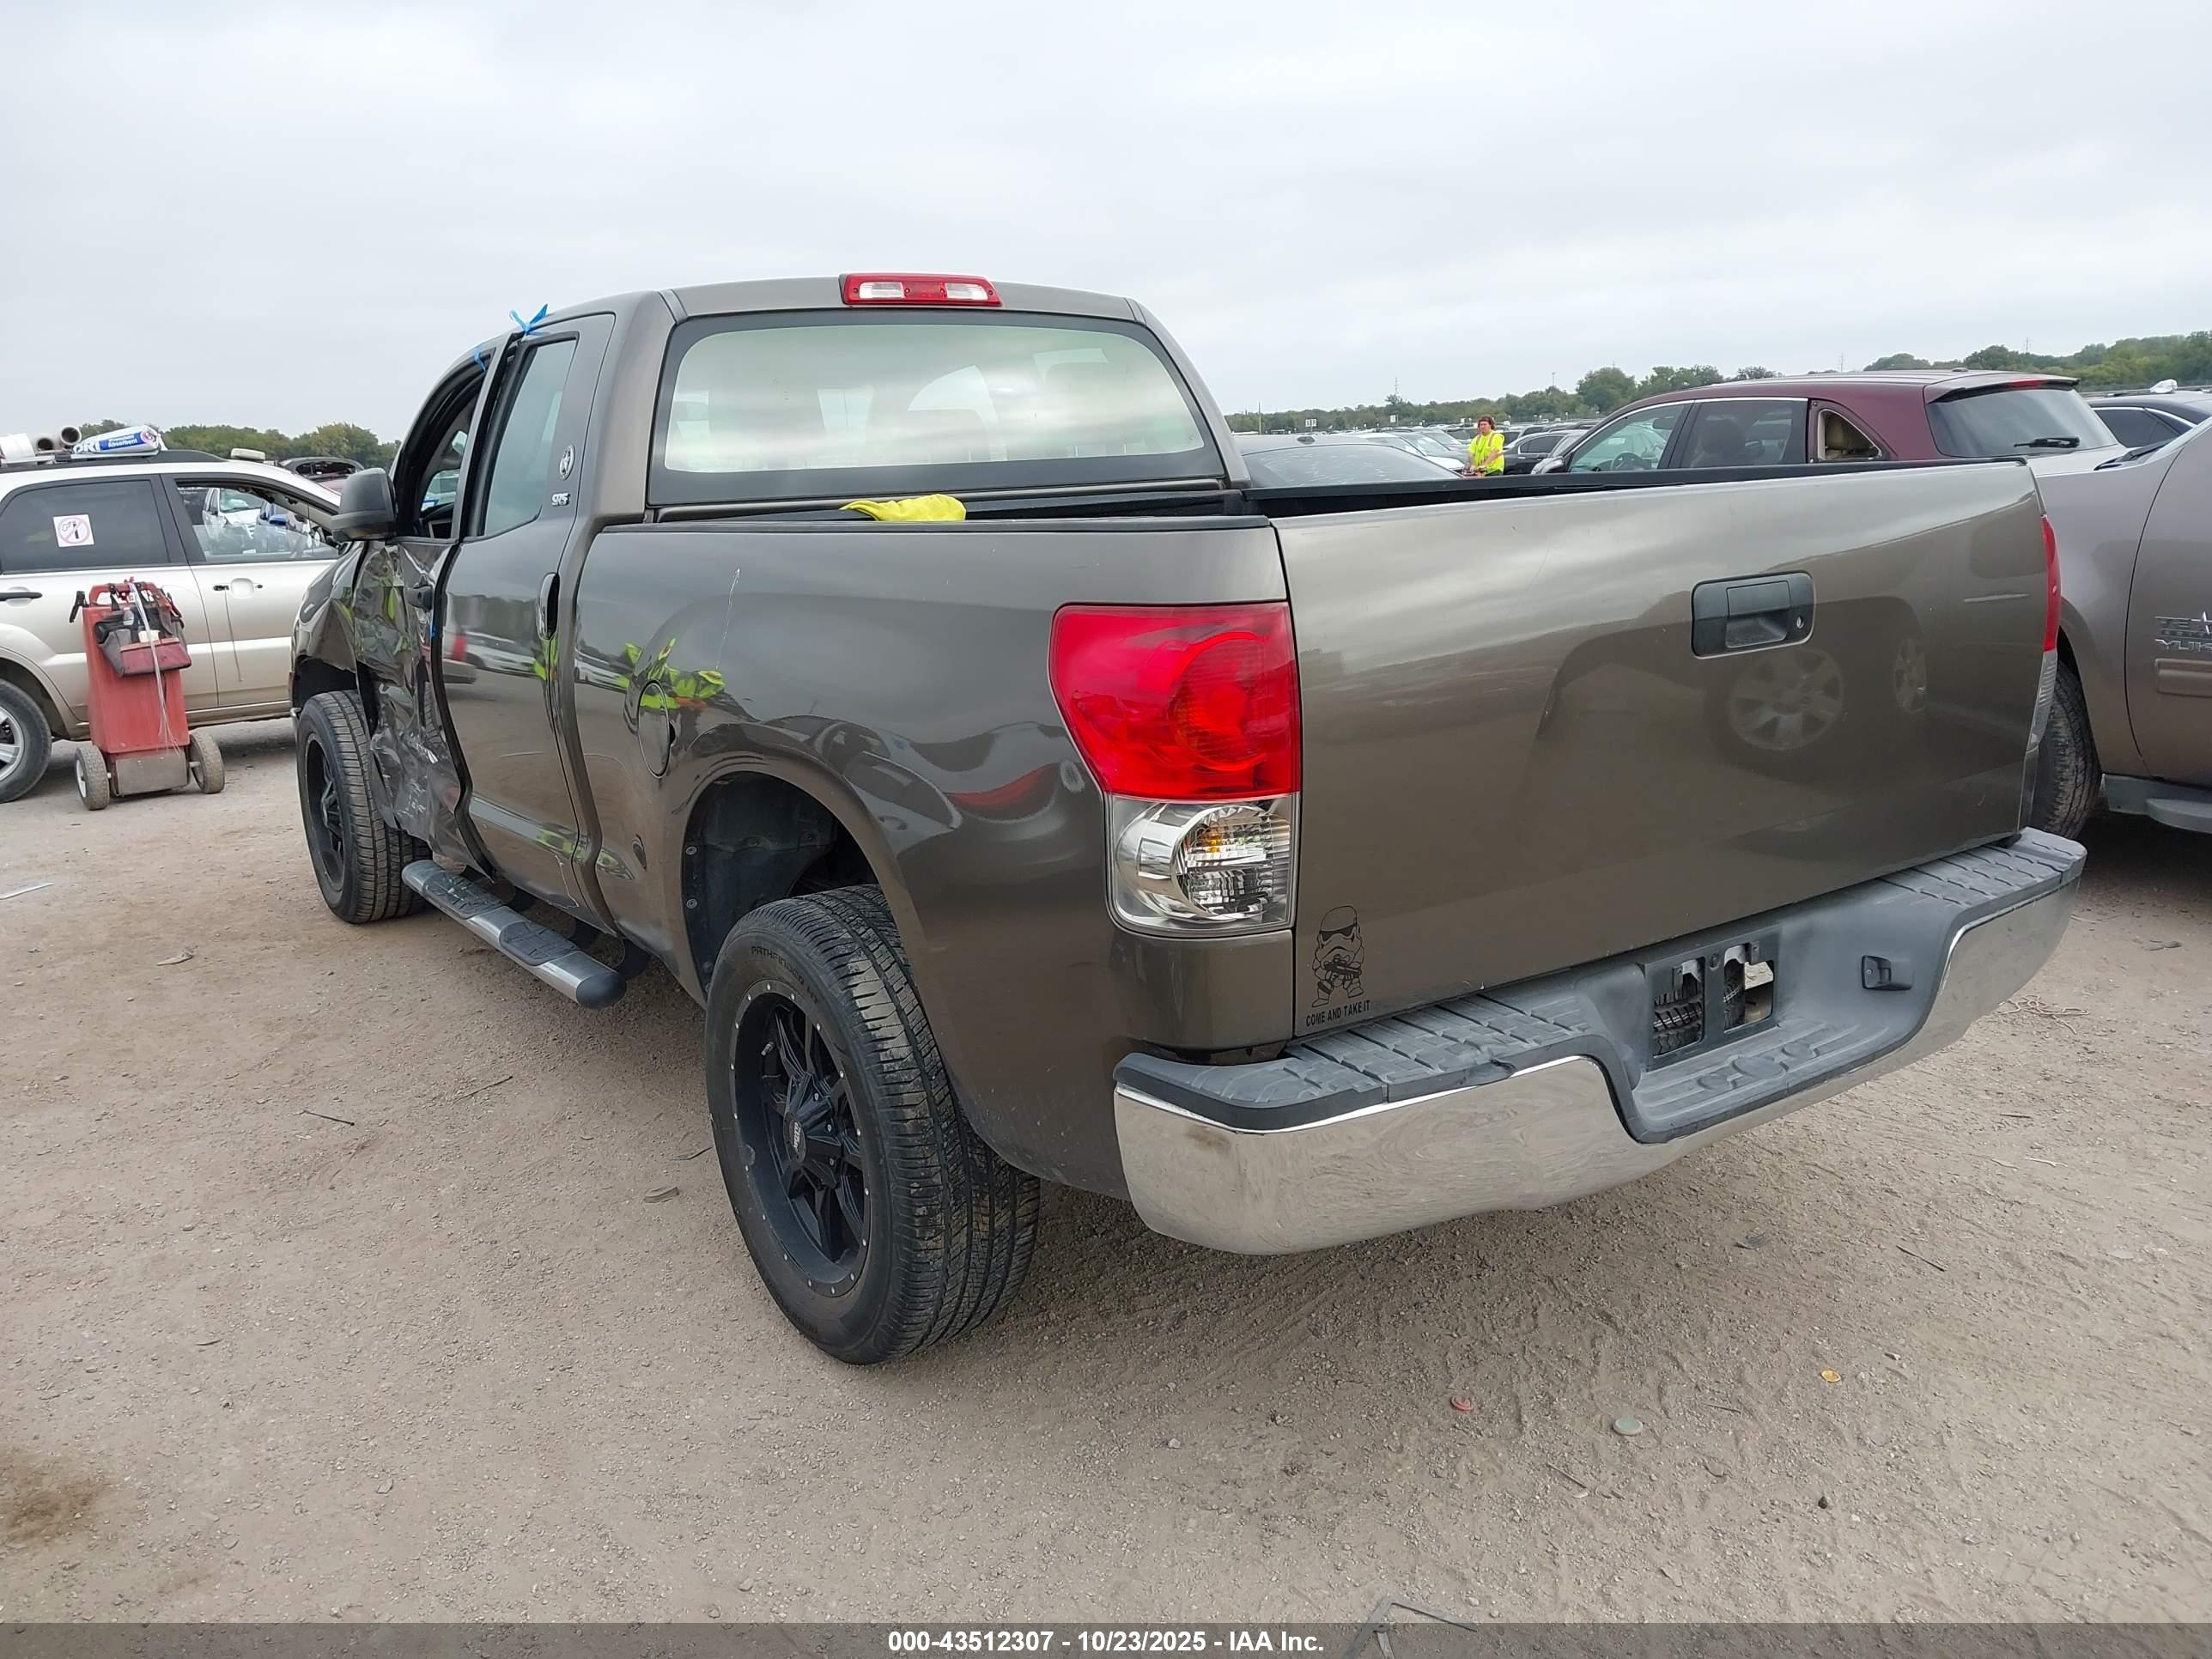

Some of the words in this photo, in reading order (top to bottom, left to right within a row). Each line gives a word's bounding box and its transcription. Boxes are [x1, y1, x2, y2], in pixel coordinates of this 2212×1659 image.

[1305, 1011, 1325, 1027] COME
[1327, 1006, 1341, 1022] AND
[1343, 1001, 1363, 1018] TAKE
[1364, 1000, 1370, 1012] IT
